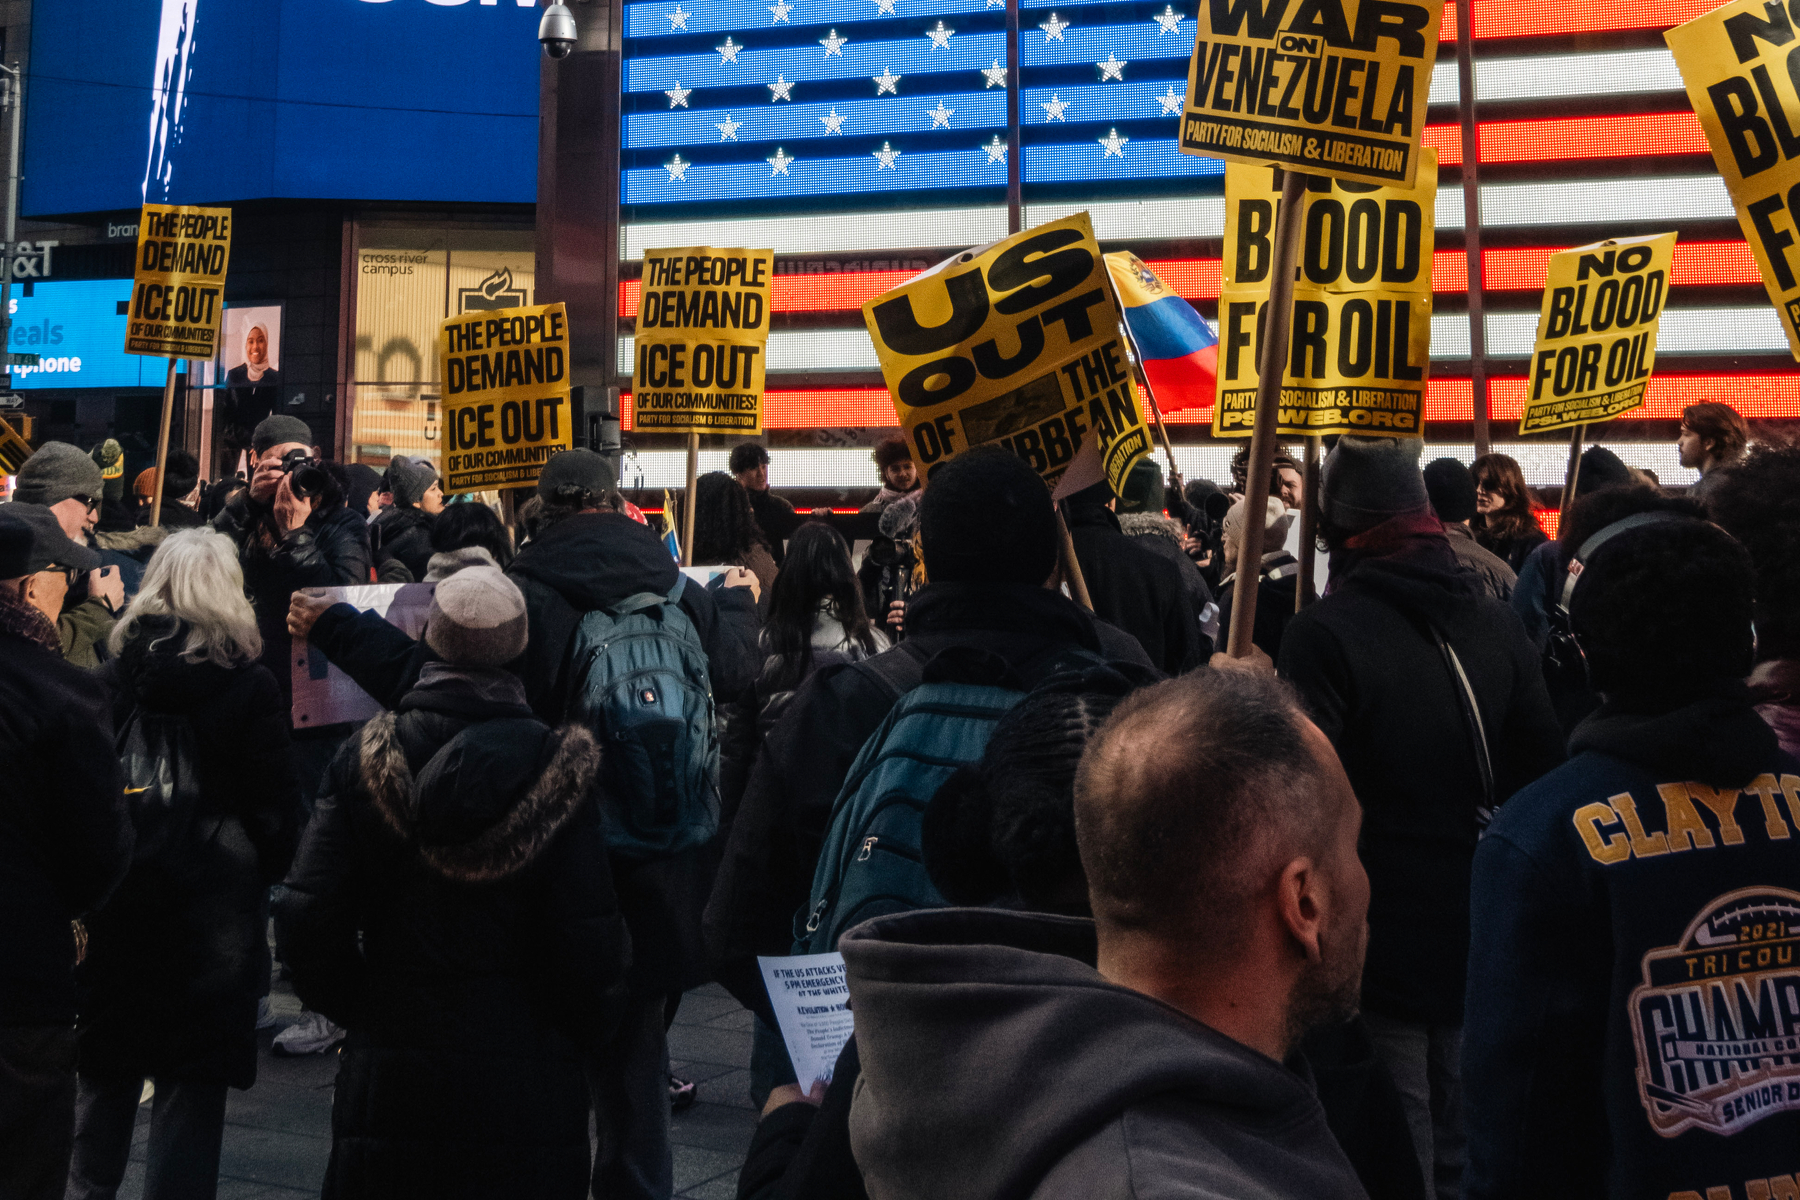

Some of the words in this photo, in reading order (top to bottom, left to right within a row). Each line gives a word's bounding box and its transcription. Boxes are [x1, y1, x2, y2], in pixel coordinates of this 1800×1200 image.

[1279, 35, 1319, 55] ON
[1193, 40, 1416, 138] VENEZUELA
[1185, 119, 1221, 145] PARTY
[1220, 125, 1242, 148] FOR
[1242, 128, 1304, 157] SOCIALISM
[1304, 137, 1321, 160] &
[1323, 139, 1404, 173] LIBERATION
[147, 212, 179, 238] THE
[179, 214, 229, 241] PEOPLE
[1235, 198, 1422, 284] BOOD
[142, 240, 226, 276] DEMAND
[362, 253, 396, 264] cross
[399, 253, 428, 264] river
[362, 264, 414, 277] campus
[648, 257, 683, 287] THE
[684, 256, 767, 288] PEOPLE
[1576, 245, 1652, 281] NO
[134, 283, 174, 321] ICE
[174, 286, 219, 325] OUT
[872, 228, 1094, 356] US
[1545, 270, 1665, 340] BLOOD
[642, 290, 764, 329] DEMAND
[8, 318, 64, 346] eals
[131, 322, 144, 336] OF
[144, 323, 163, 338] OUR
[444, 321, 483, 353] THE
[485, 312, 563, 349] PEOPLE
[1337, 298, 1422, 382] OIL
[898, 287, 1106, 407] OUT
[447, 346, 564, 395] DEMAND
[639, 343, 686, 388] ICE
[691, 344, 760, 390] OUT
[1533, 341, 1603, 400] FOR
[1604, 332, 1650, 388] OIL
[637, 392, 650, 409] OF
[651, 393, 673, 409] OUR
[674, 393, 758, 411] COMMUNITIES!
[912, 413, 955, 464] OF
[1061, 339, 1128, 403] THE
[1224, 391, 1257, 410] PARTY
[1279, 389, 1336, 408] SOCIALISM
[1336, 390, 1350, 408] &
[1352, 390, 1417, 410] LIBERATION
[1529, 406, 1553, 418] PARTY
[1551, 403, 1565, 414] FOR
[1565, 396, 1602, 411] SOCIALISM
[1601, 394, 1610, 406] &
[449, 403, 496, 451] ICE
[500, 397, 564, 445] OUT
[639, 414, 658, 425] PARTY
[658, 414, 671, 424] FOR
[671, 414, 707, 425] SOCIALISM
[707, 415, 713, 425] &
[714, 416, 755, 427] LIBERATION
[1222, 409, 1415, 428] PSWEB.ORG
[448, 455, 462, 472] OF
[463, 452, 485, 469] OUR
[451, 475, 471, 487] PARTY
[471, 474, 483, 484] FOR
[484, 470, 519, 482] SOCIALISM
[1740, 921, 1785, 942] 2021
[773, 969, 780, 979] IF
[780, 968, 795, 979] THE
[795, 969, 805, 978] US
[805, 965, 836, 977] ATTACKS
[1685, 954, 1728, 977] TRI
[790, 979, 802, 989] PM
[801, 975, 844, 989] EMERGENCY
[822, 985, 849, 996] WHITE
[1696, 1041, 1769, 1056] NATIONAL
[1722, 1084, 1783, 1123] SENIOR
